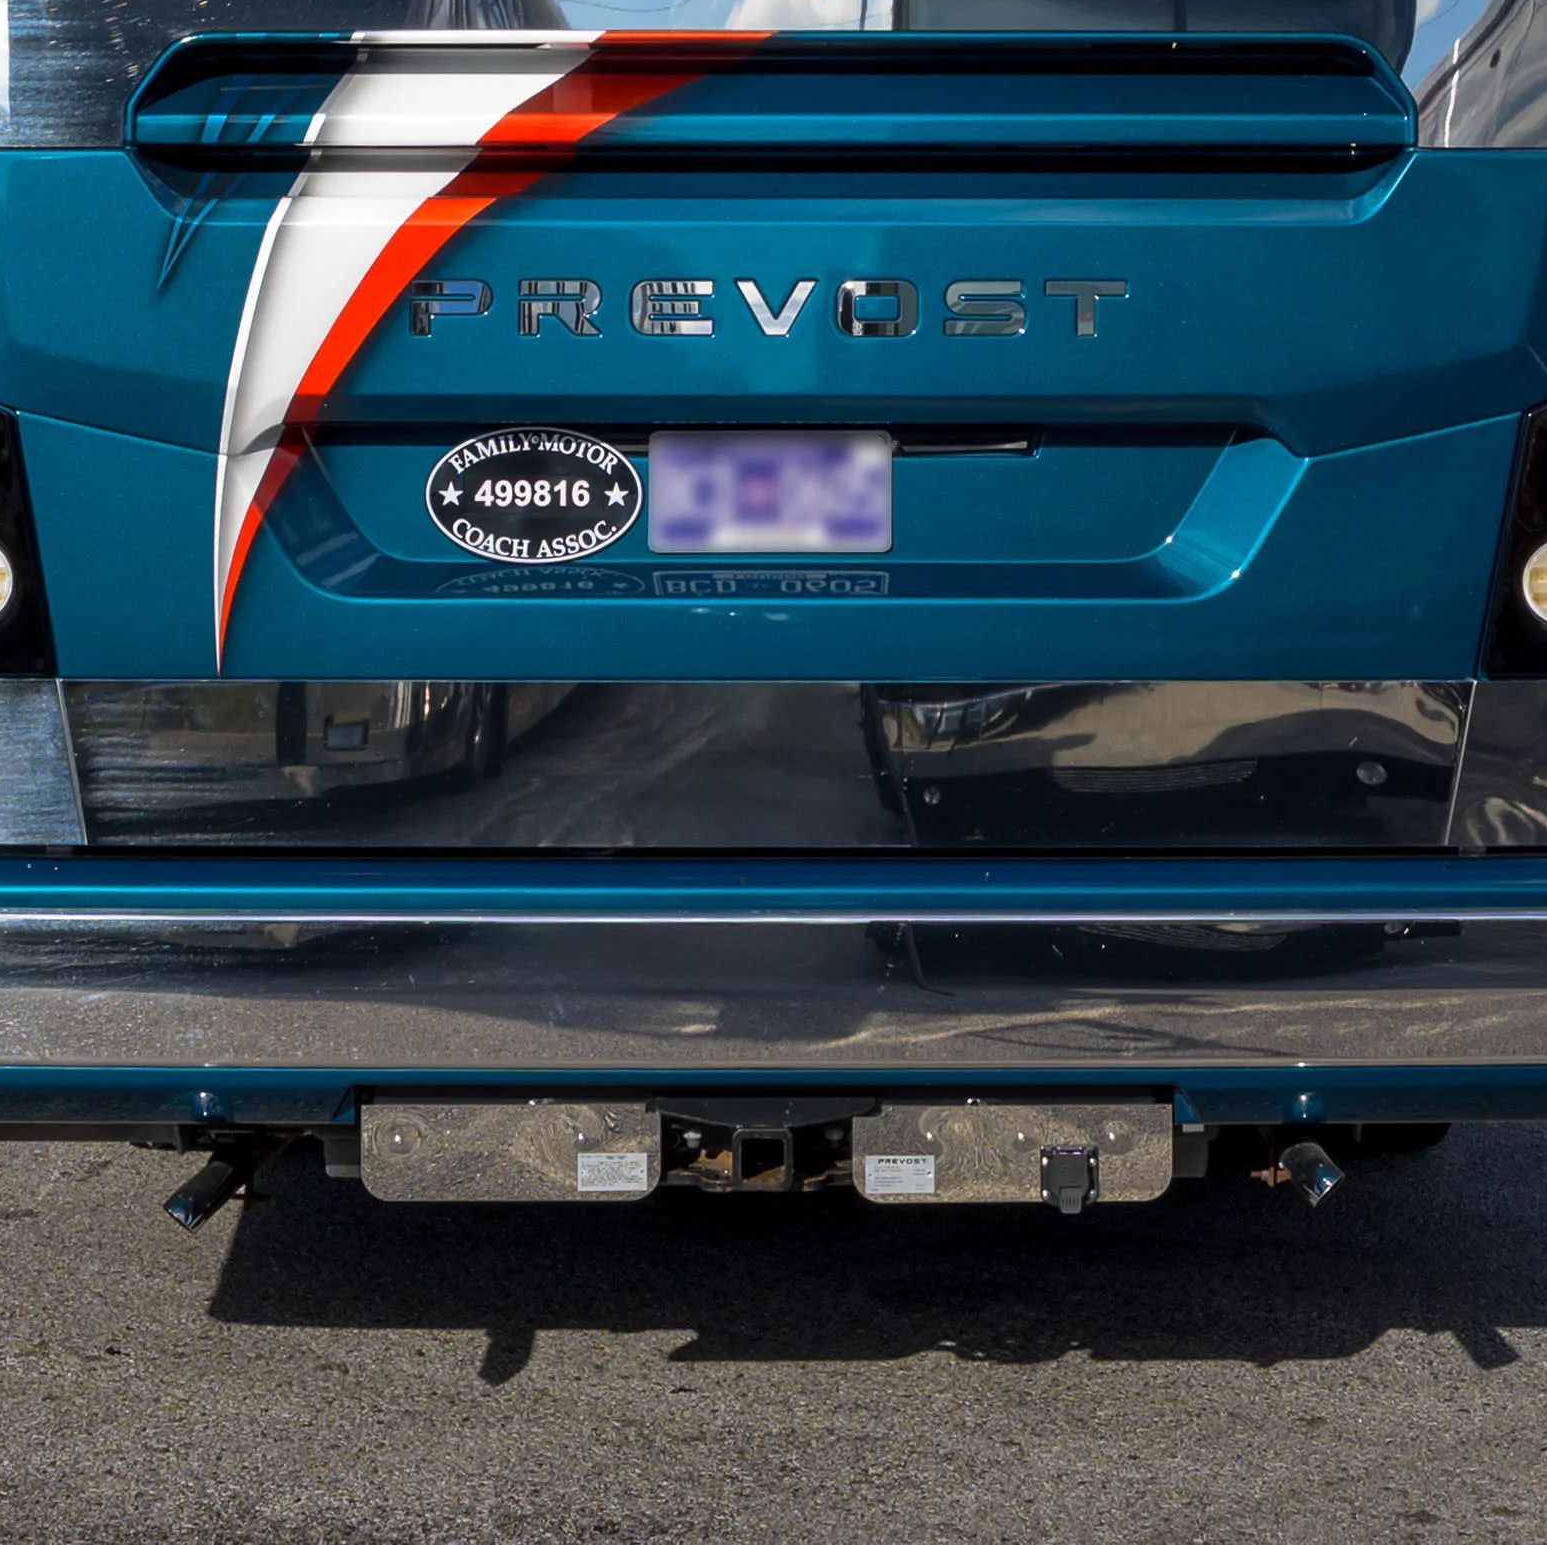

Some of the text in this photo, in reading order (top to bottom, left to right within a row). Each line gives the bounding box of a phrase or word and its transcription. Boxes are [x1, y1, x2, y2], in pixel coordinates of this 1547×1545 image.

[409, 278, 1130, 338] PREVOST
[448, 432, 619, 475] FAMILY MOTOR
[474, 479, 591, 508] 499816
[451, 518, 618, 559] COACH ASSOC.
